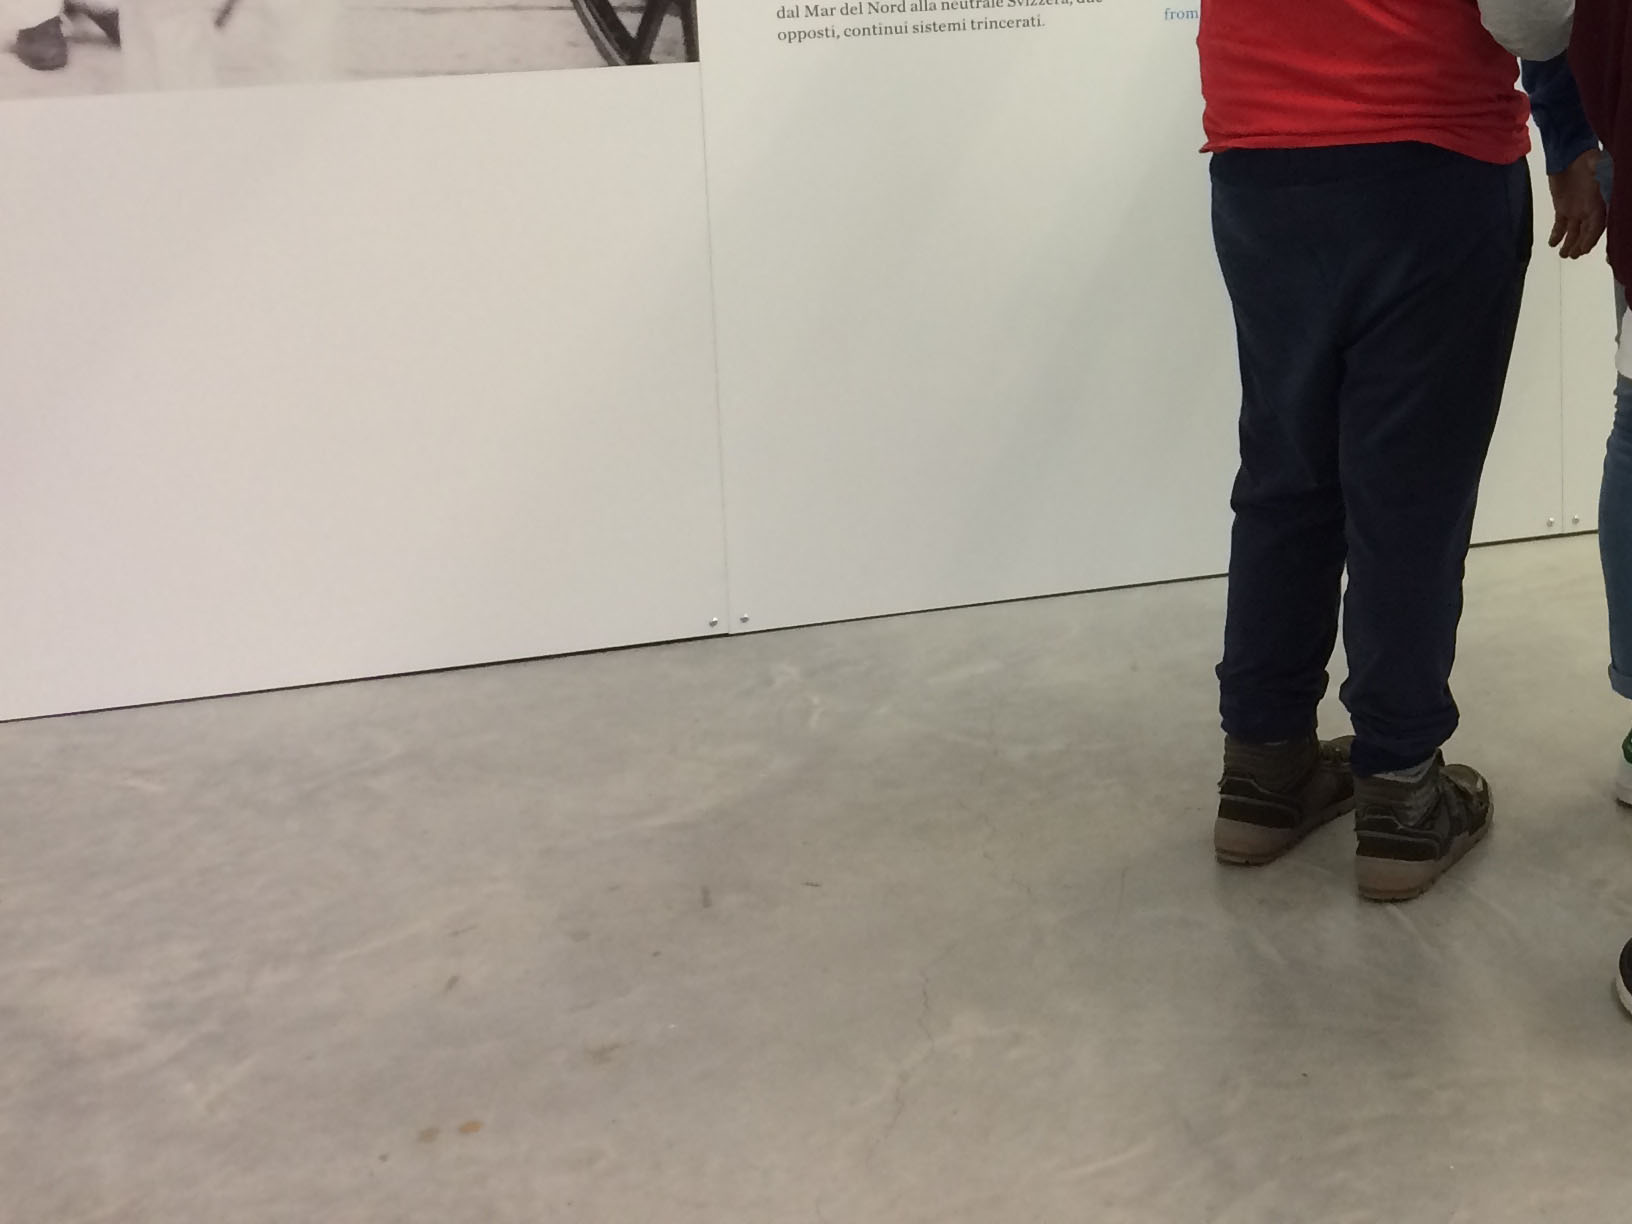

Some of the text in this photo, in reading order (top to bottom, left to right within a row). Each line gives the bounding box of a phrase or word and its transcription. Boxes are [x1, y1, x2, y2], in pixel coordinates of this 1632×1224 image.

[777, 13, 1045, 44] opposti, continui sistemi trincerati.
